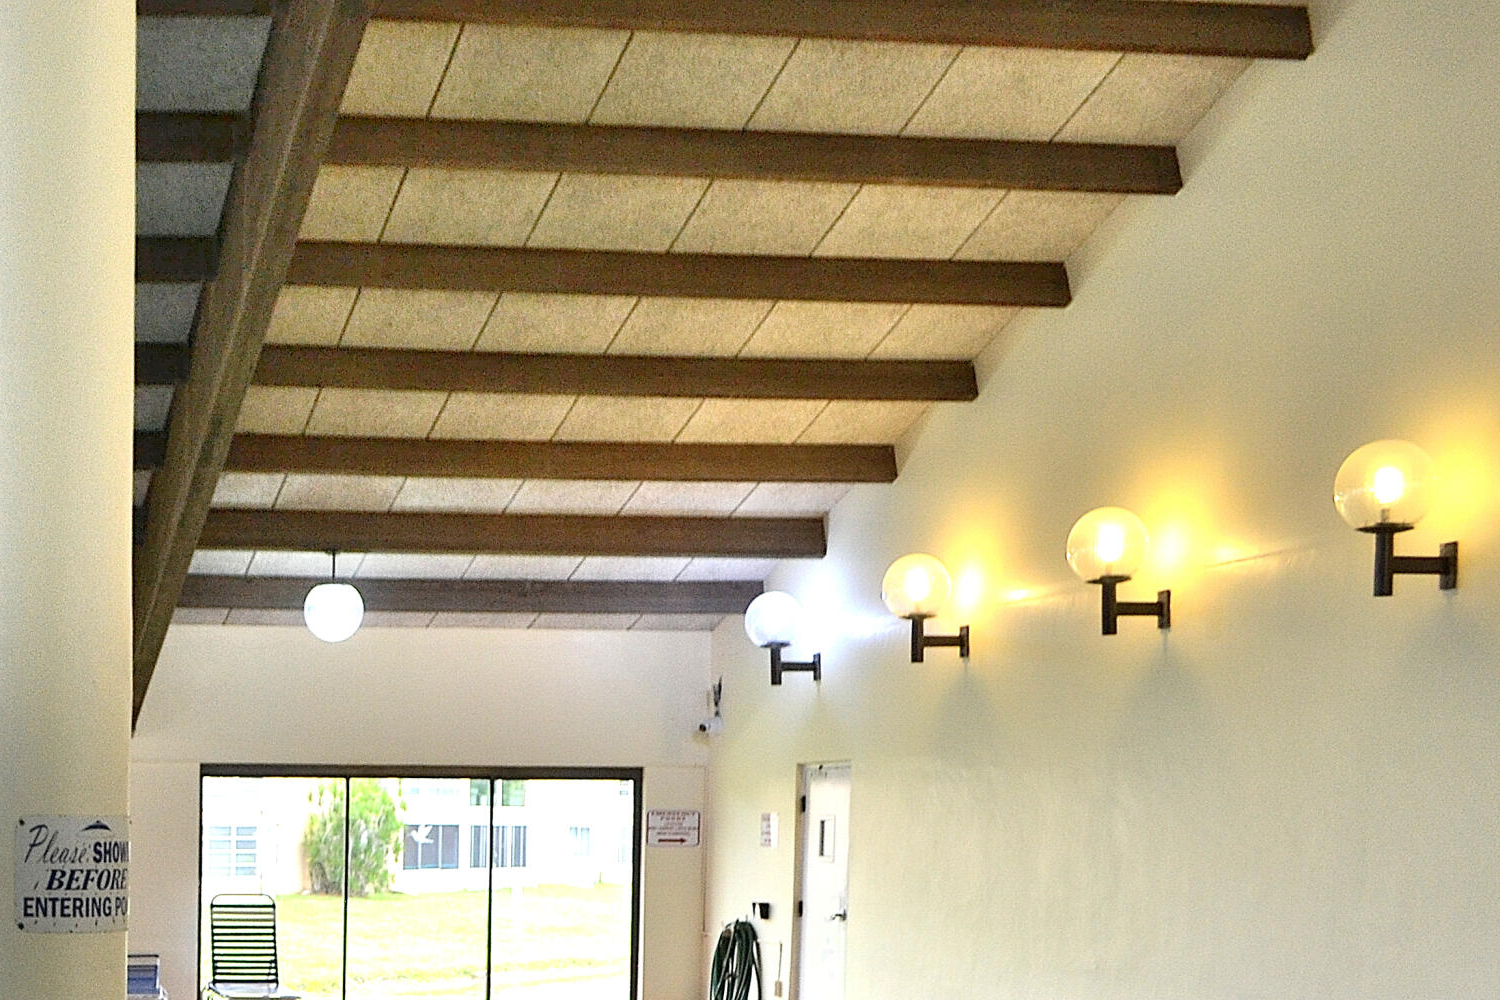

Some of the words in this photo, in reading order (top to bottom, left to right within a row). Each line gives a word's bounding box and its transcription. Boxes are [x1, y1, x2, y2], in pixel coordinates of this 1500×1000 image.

[25, 824, 89, 864] Please
[93, 841, 129, 863] SHOW
[46, 868, 128, 890] BEFORE
[23, 897, 112, 917] ENTERING
[115, 897, 128, 916] PO
